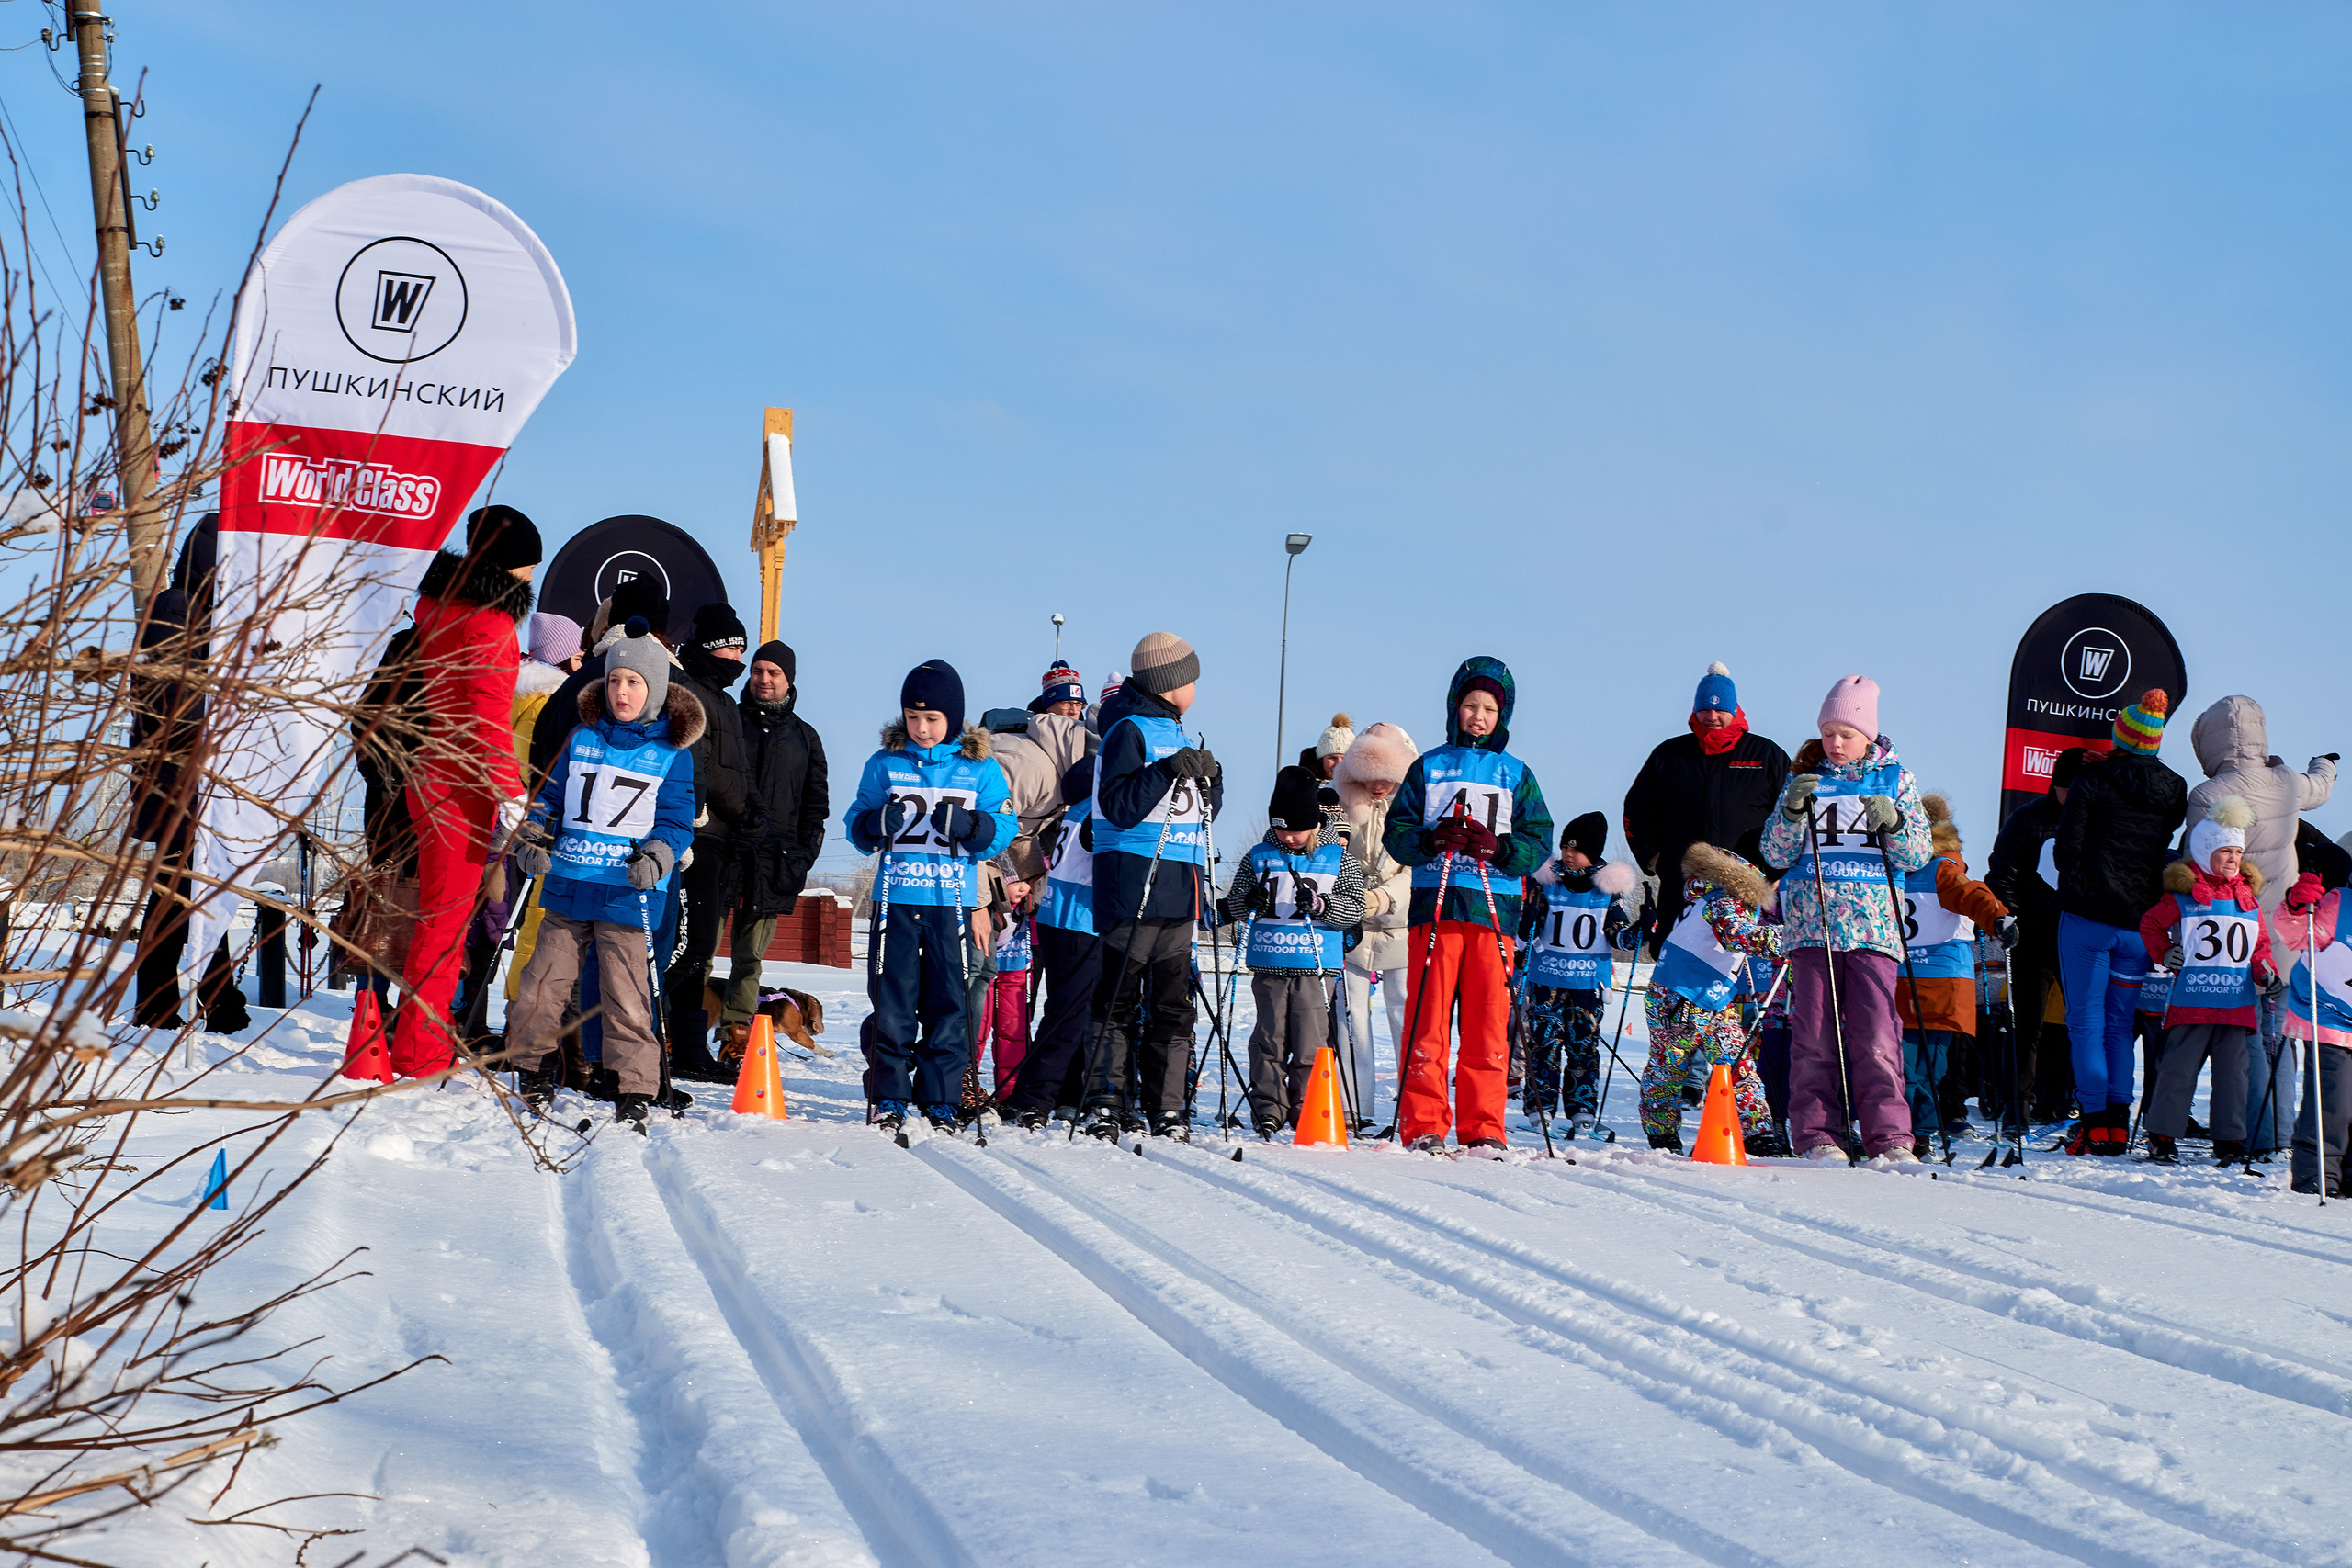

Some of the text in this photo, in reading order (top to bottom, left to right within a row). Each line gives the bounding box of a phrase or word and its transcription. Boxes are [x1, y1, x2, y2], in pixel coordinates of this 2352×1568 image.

[381, 279, 424, 324] W
[267, 366, 505, 413] ПУШКИНСКИЙ
[266, 458, 435, 513] World Class
[2084, 650, 2109, 677] W
[2027, 698, 2122, 722] ПУШКИНС
[2026, 750, 2057, 775] Wor
[572, 772, 651, 828] 17
[1437, 788, 1499, 833] 41
[1158, 818, 1171, 852] NORDWAY
[890, 876, 936, 887] UTDOOR
[1426, 863, 1479, 874] OUDOOR
[1436, 858, 1452, 906] MADSHUS
[881, 870, 890, 916] NORDWAY
[954, 877, 964, 921] NORDWAY
[1478, 868, 1497, 914] MADSHUS
[665, 888, 689, 970] BLACKSQUA
[1252, 944, 1296, 954] OUTDOOR
[1549, 910, 1597, 950] 10
[2194, 919, 2249, 963] 30
[996, 951, 1019, 959] DOOR
[1537, 965, 1574, 977] OUTDOOR
[2140, 992, 2166, 1000] TDOOR
[2185, 986, 2229, 994] OUTDOOR
